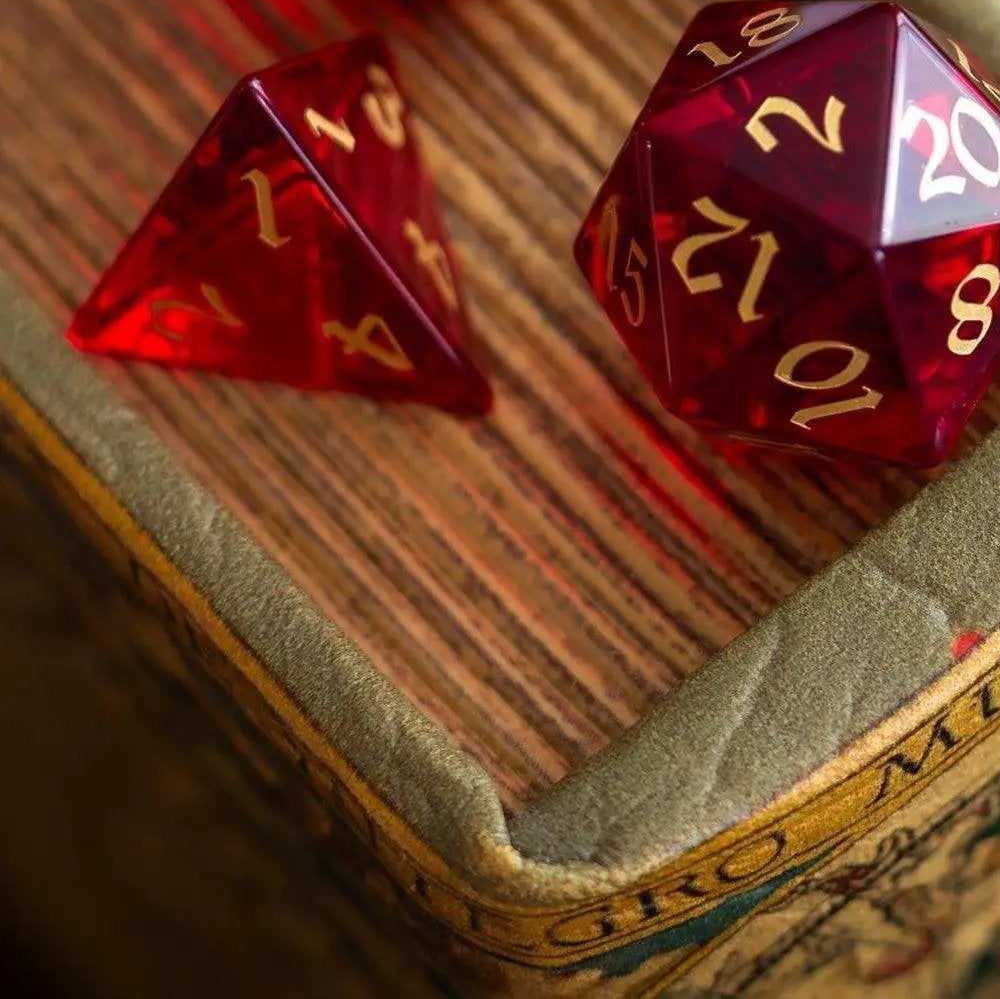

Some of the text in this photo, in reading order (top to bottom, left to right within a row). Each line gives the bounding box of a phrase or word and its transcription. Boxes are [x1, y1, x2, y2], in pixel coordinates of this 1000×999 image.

[687, 6, 802, 67] 18
[745, 95, 847, 153] 2
[240, 168, 292, 249] 1
[671, 196, 781, 323] 12
[321, 313, 415, 371] 4
[773, 340, 884, 430] 10
